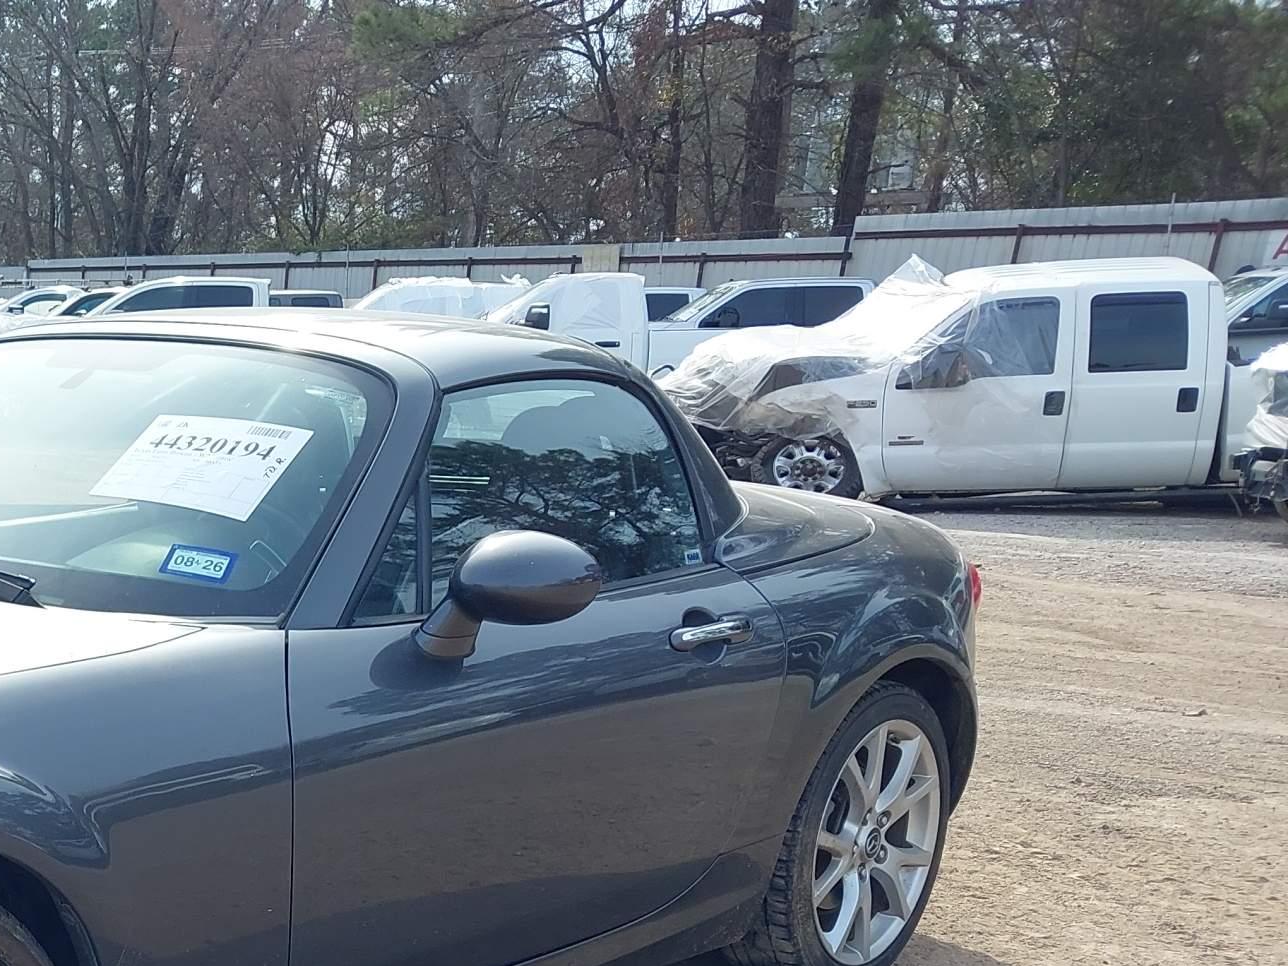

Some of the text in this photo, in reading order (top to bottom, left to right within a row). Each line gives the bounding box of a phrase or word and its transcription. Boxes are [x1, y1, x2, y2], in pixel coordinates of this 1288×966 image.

[149, 433, 277, 461] 44320194
[174, 555, 225, 573] 08 26
